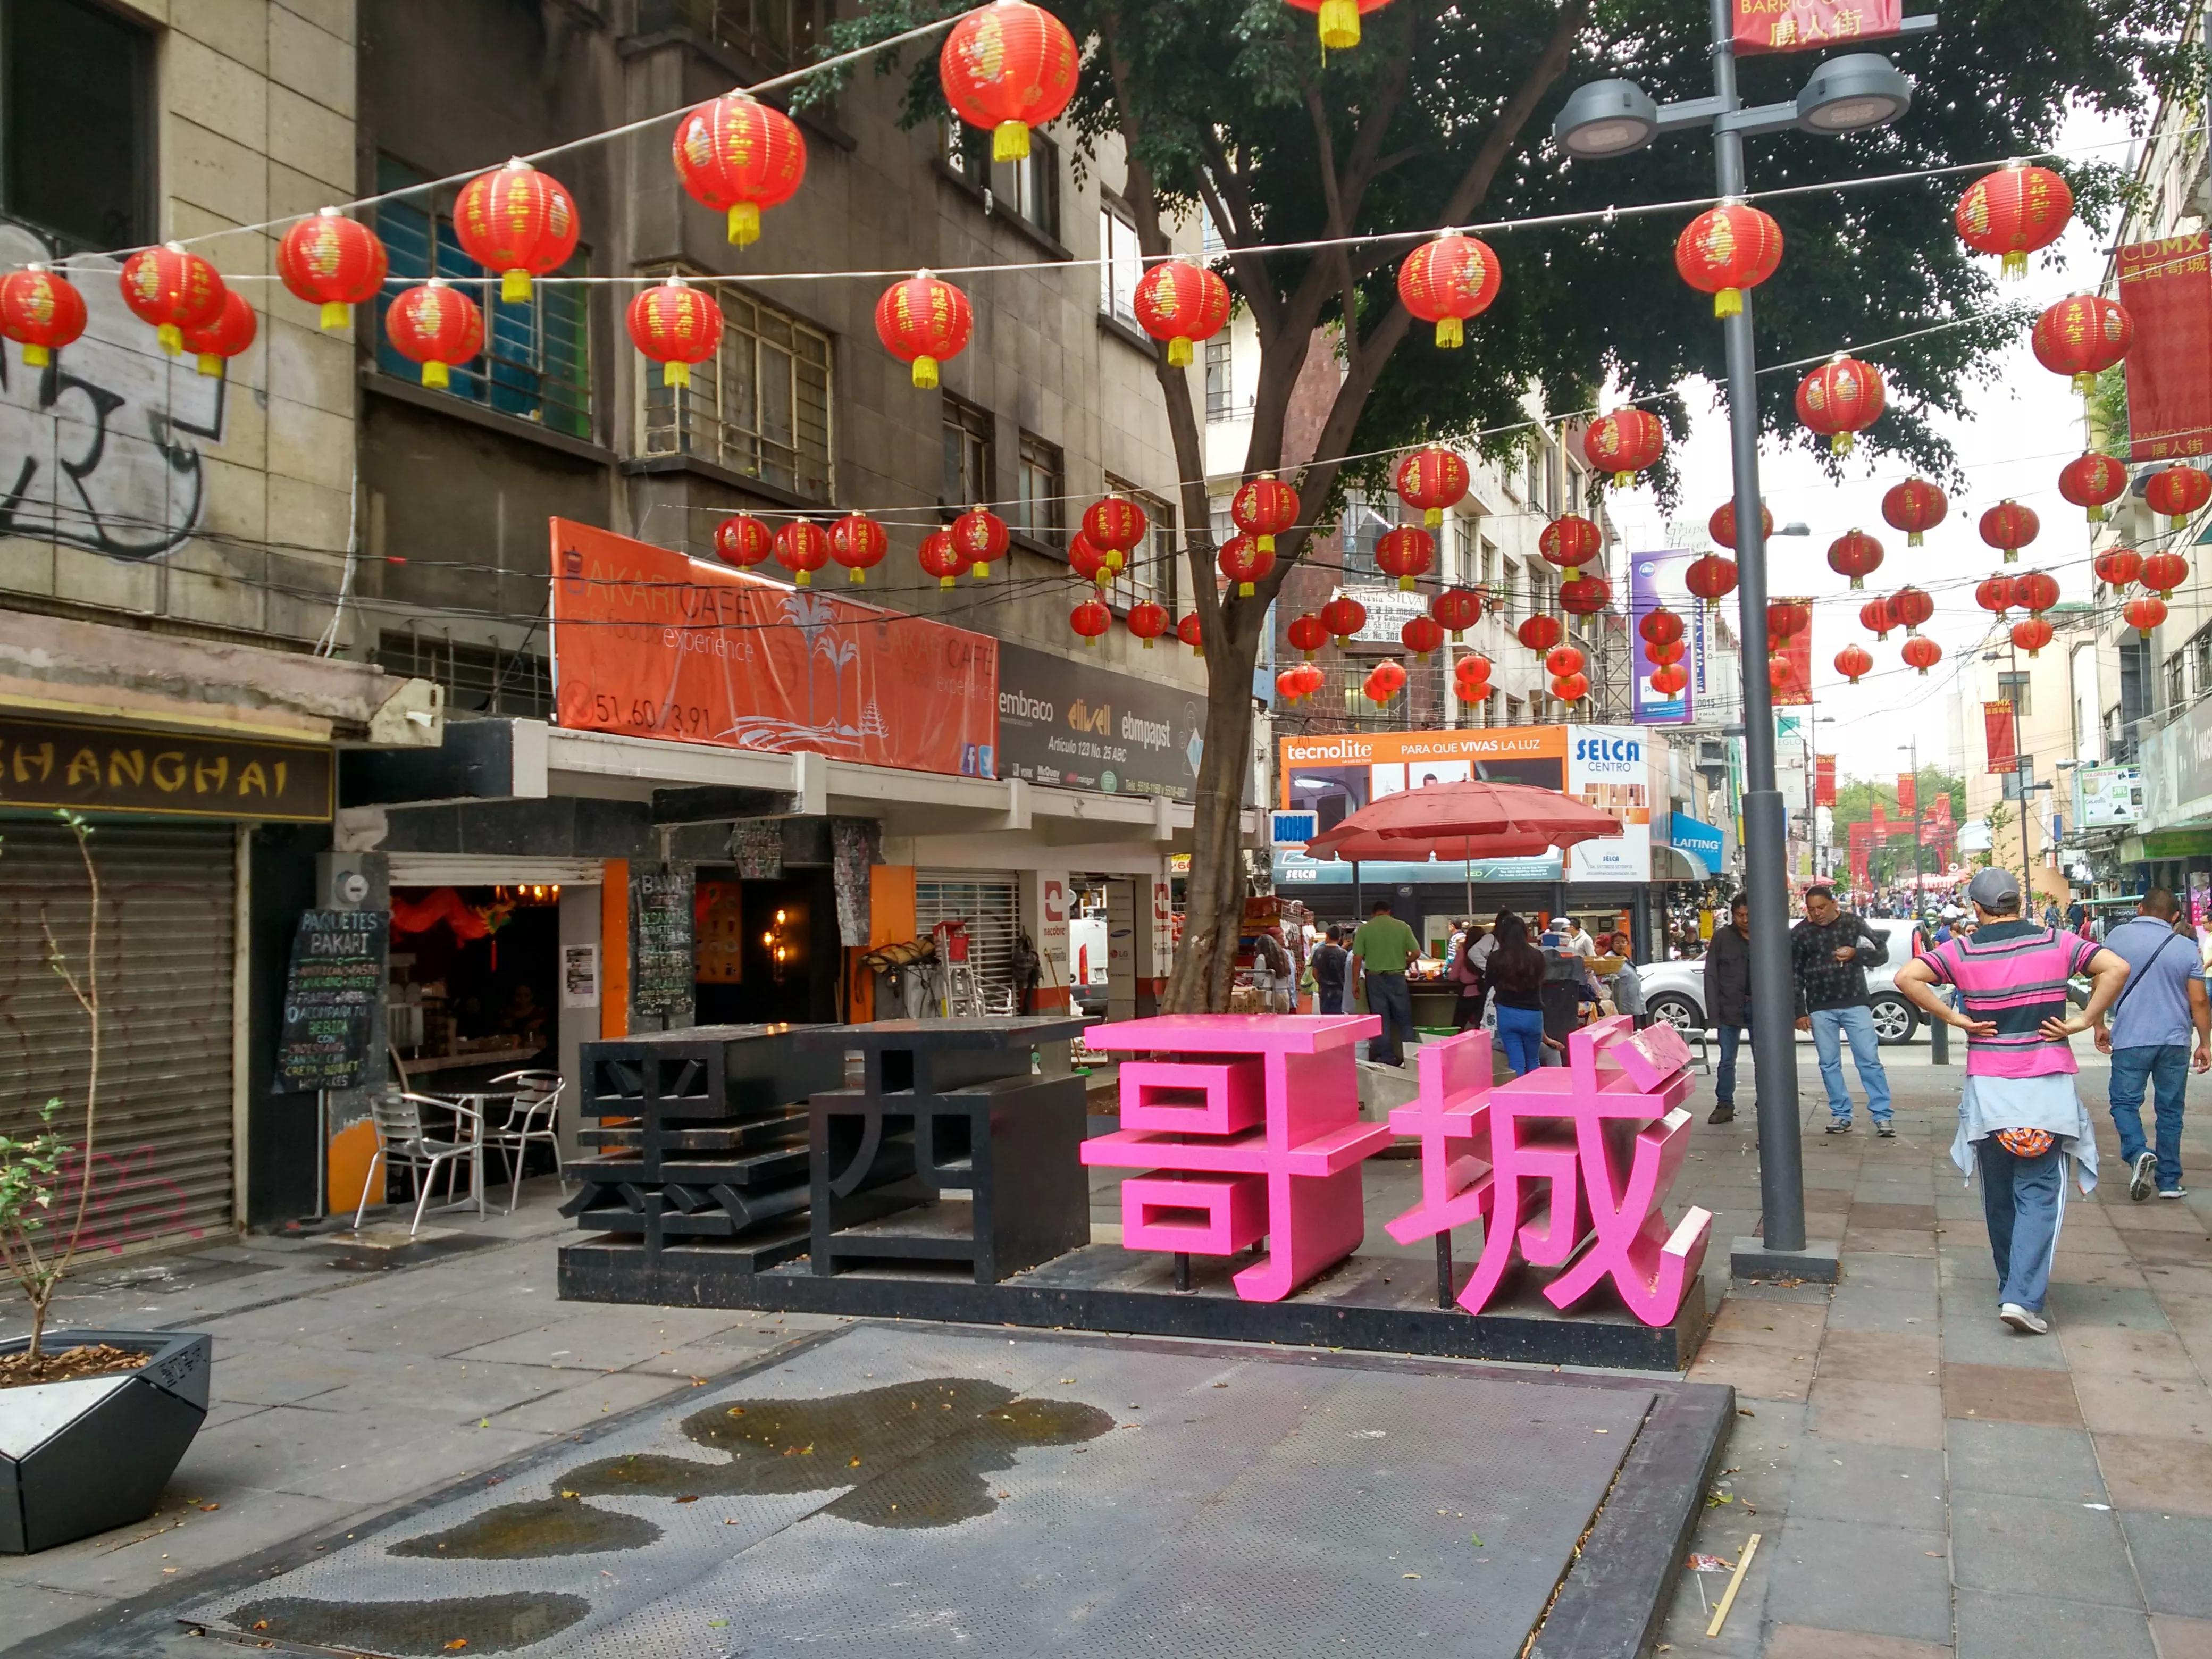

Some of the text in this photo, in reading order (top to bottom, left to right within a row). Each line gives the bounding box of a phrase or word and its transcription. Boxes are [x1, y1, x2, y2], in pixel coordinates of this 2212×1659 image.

[1769, 9, 1863, 46] 唐人街
[2122, 232, 2205, 261] CDMX
[2123, 256, 2208, 283] 墨西哥城
[2152, 439, 2204, 457] 唐人街
[1385, 605, 1393, 614] la
[1387, 592, 1423, 607] SILVA
[663, 625, 754, 663] experience
[1386, 632, 1399, 640] 308
[999, 690, 1053, 722] embraco
[1068, 698, 1111, 736] eliwell
[1122, 710, 1170, 751] ebmpapst
[1048, 735, 1127, 762] Artículo 123 No. 25 ABC
[1287, 739, 1540, 760] tecnolite PARA QUE VIVAS LA LUZ
[1577, 739, 1640, 762] SELCA
[1588, 761, 1631, 772] CENTRO
[1673, 837, 1719, 850] LAITING
[1285, 869, 1317, 879] SELCA
[302, 912, 378, 931] PAQUETES
[311, 933, 371, 955] BAKARI
[308, 1020, 348, 1035] BEBIDA
